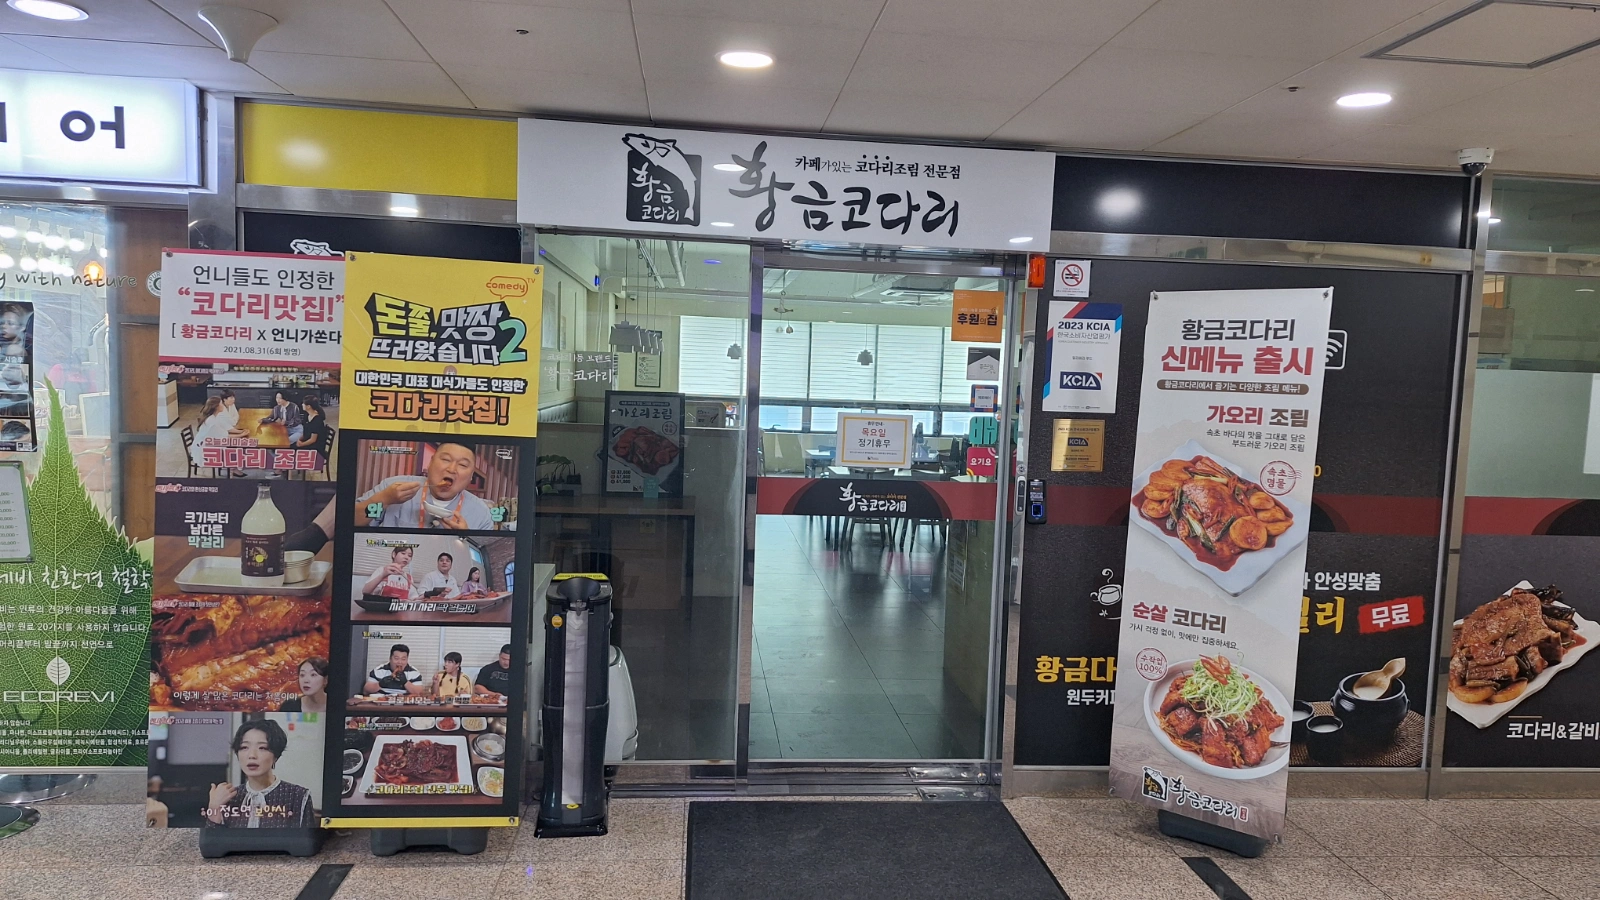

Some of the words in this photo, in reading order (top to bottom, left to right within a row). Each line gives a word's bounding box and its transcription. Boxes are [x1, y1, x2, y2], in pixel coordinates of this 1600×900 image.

[795, 156, 852, 173] 카페가있는
[854, 159, 920, 176] 코다리조림
[922, 165, 961, 180] 전문점
[728, 141, 960, 237] 황금코다리
[641, 205, 680, 221] 코다리
[15, 271, 62, 286] with
[71, 273, 138, 287] nature
[193, 265, 269, 287] 언니들도
[277, 269, 335, 290] 인정한
[486, 281, 525, 292] comedy
[440, 303, 503, 341] 맛짱
[957, 313, 998, 326] 후원의집
[1058, 321, 1083, 330] 2023
[1086, 322, 1111, 331] KCIA
[180, 326, 252, 341] 황금코다리
[270, 328, 342, 344] 언니가쏜다
[1057, 331, 1111, 340] 한국소비자산업평가
[1181, 319, 1296, 341] 황금코다리
[498, 318, 527, 362] 2
[223, 346, 282, 356] 2021.08.31(6회
[1161, 346, 1244, 374] 신메뉴
[1253, 346, 1314, 375] 출시
[355, 371, 402, 386] 대한민국
[405, 374, 429, 388] 대표
[431, 376, 488, 391] 대식가들도
[491, 379, 526, 393] 인정한
[1062, 374, 1097, 387] KCIA
[1164, 380, 1213, 390] 황금코다리에서
[1214, 381, 1237, 391] 즐기는
[1239, 382, 1263, 392] 다양한
[1264, 383, 1280, 392] 조림
[1282, 384, 1301, 394] 메뉴!
[369, 390, 512, 425] 코다리맛집!
[617, 407, 650, 419] 가오리
[651, 408, 672, 420] 조림
[1206, 405, 1263, 425] 가오리
[1269, 408, 1309, 427] 조림
[862, 427, 886, 438] 목요일
[1206, 428, 1221, 437] 속초
[1223, 430, 1245, 438] 바다의
[1247, 431, 1263, 440] 맛을
[1264, 433, 1288, 441] 그대로
[1290, 434, 1306, 442] 담은
[858, 438, 891, 448] 정기휴무
[1232, 439, 1262, 449] 부드러운
[1264, 441, 1287, 451] 가오리
[1289, 443, 1305, 452] 조림
[202, 447, 267, 468] 코다리
[273, 449, 318, 470] 조림
[970, 457, 992, 466] 요기요
[1267, 466, 1289, 478] 속초
[839, 482, 900, 512] 황금코다리
[366, 502, 383, 518] 와
[184, 511, 229, 524] 크기부터
[190, 524, 223, 536] 남다른
[188, 536, 225, 549] 막걸리
[42, 565, 104, 590] 친환경
[112, 565, 152, 594] 철학
[1315, 571, 1382, 592] 안성맞춤
[19, 604, 44, 615] 인류의
[75, 604, 118, 616] 아름다움을
[120, 605, 137, 615] 위해
[1132, 600, 1168, 623] 순살
[1172, 612, 1228, 634] 코다리
[1371, 604, 1411, 629] 무료
[18, 622, 35, 632] 원료
[38, 622, 73, 632] 20가지를
[77, 624, 110, 633] 사용하지
[1129, 622, 1143, 632] 가시
[1145, 625, 1159, 635] 걱정
[1160, 628, 1176, 639] 없이,
[1178, 630, 1199, 643] 맛에만
[1201, 635, 1239, 651] 집중하세요.
[1140, 655, 1164, 666] 수작업
[1139, 662, 1163, 675] 100%
[3, 690, 115, 703] ECOREVI
[173, 690, 200, 701] 이렇게
[231, 692, 262, 702] 코다리는
[264, 692, 298, 703] 처음이야
[1506, 721, 1600, 741] 코다리&갈비
[375, 784, 424, 795] 코다리조림
[1170, 776, 1238, 818] 황금코다리
[206, 807, 217, 816] 이
[254, 805, 286, 818] 보양식
